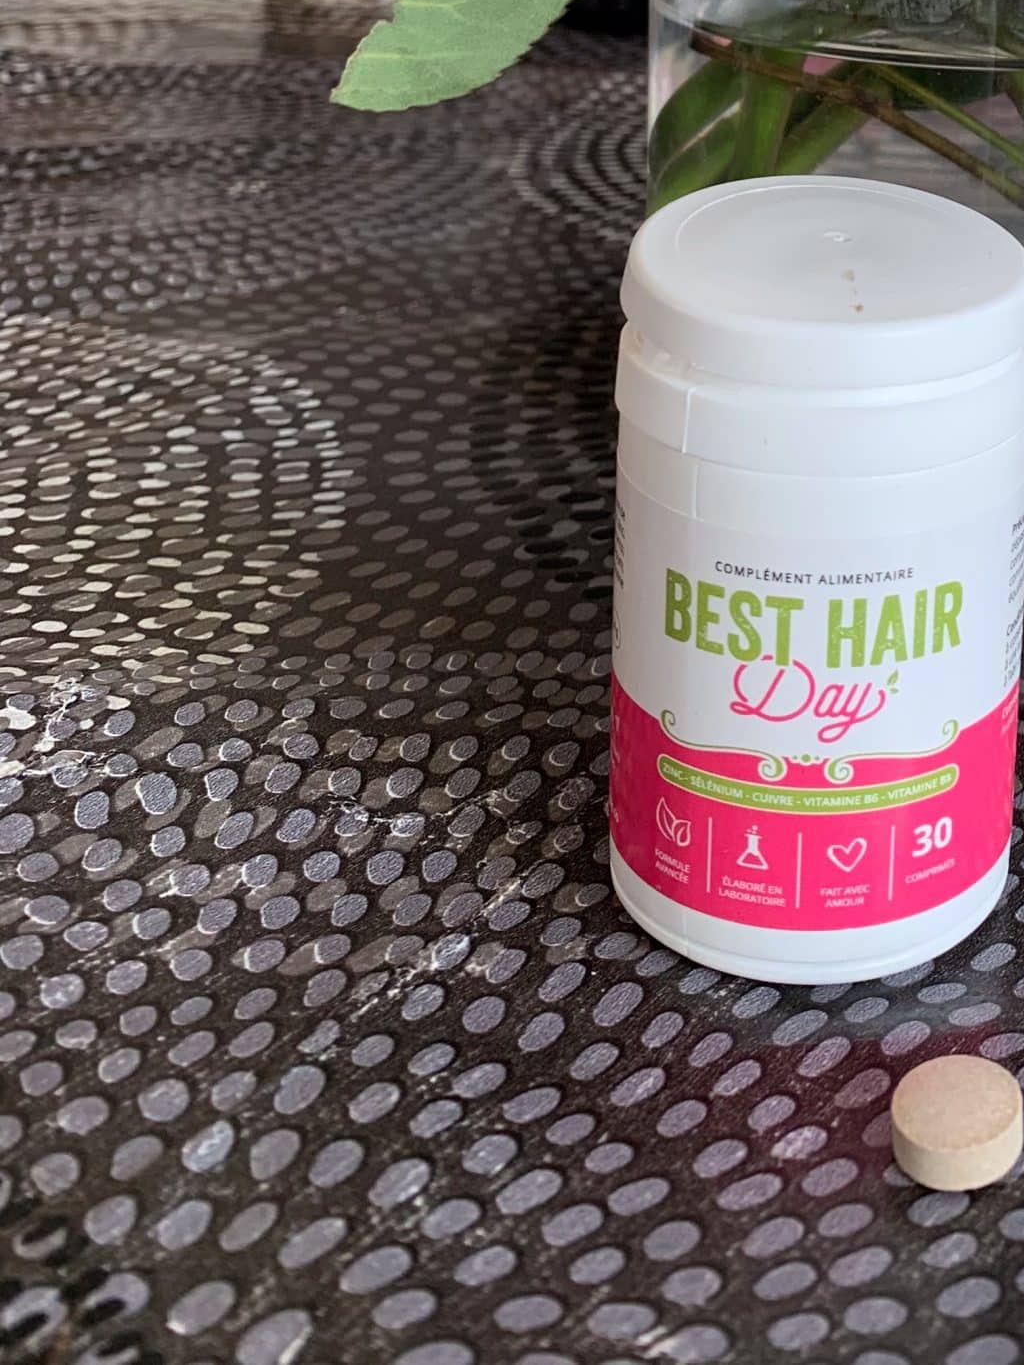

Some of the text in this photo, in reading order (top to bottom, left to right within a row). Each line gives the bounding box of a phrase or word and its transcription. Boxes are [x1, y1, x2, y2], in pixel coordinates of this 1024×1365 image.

[715, 561, 914, 585] COMPLÉMENT ALIMENTAIRE
[665, 567, 804, 667] BEST
[826, 580, 963, 668] HAIR
[730, 655, 886, 744] Day
[662, 763, 683, 780] ZINC
[691, 775, 743, 798] SÉLÉNIUM
[752, 792, 793, 806] CUIVRE
[803, 794, 862, 807] VITAMINE
[864, 793, 879, 805] B6
[887, 778, 938, 800] VITAMINE
[912, 816, 953, 858] 30
[655, 848, 691, 874] FORMULE
[655, 860, 689, 884] AVANCÉE
[718, 887, 786, 907] LABORATOIRE
[722, 875, 783, 895] ÉLABORÉ EN
[820, 884, 870, 897] FAIT AVEC
[824, 896, 864, 908] AMOUR
